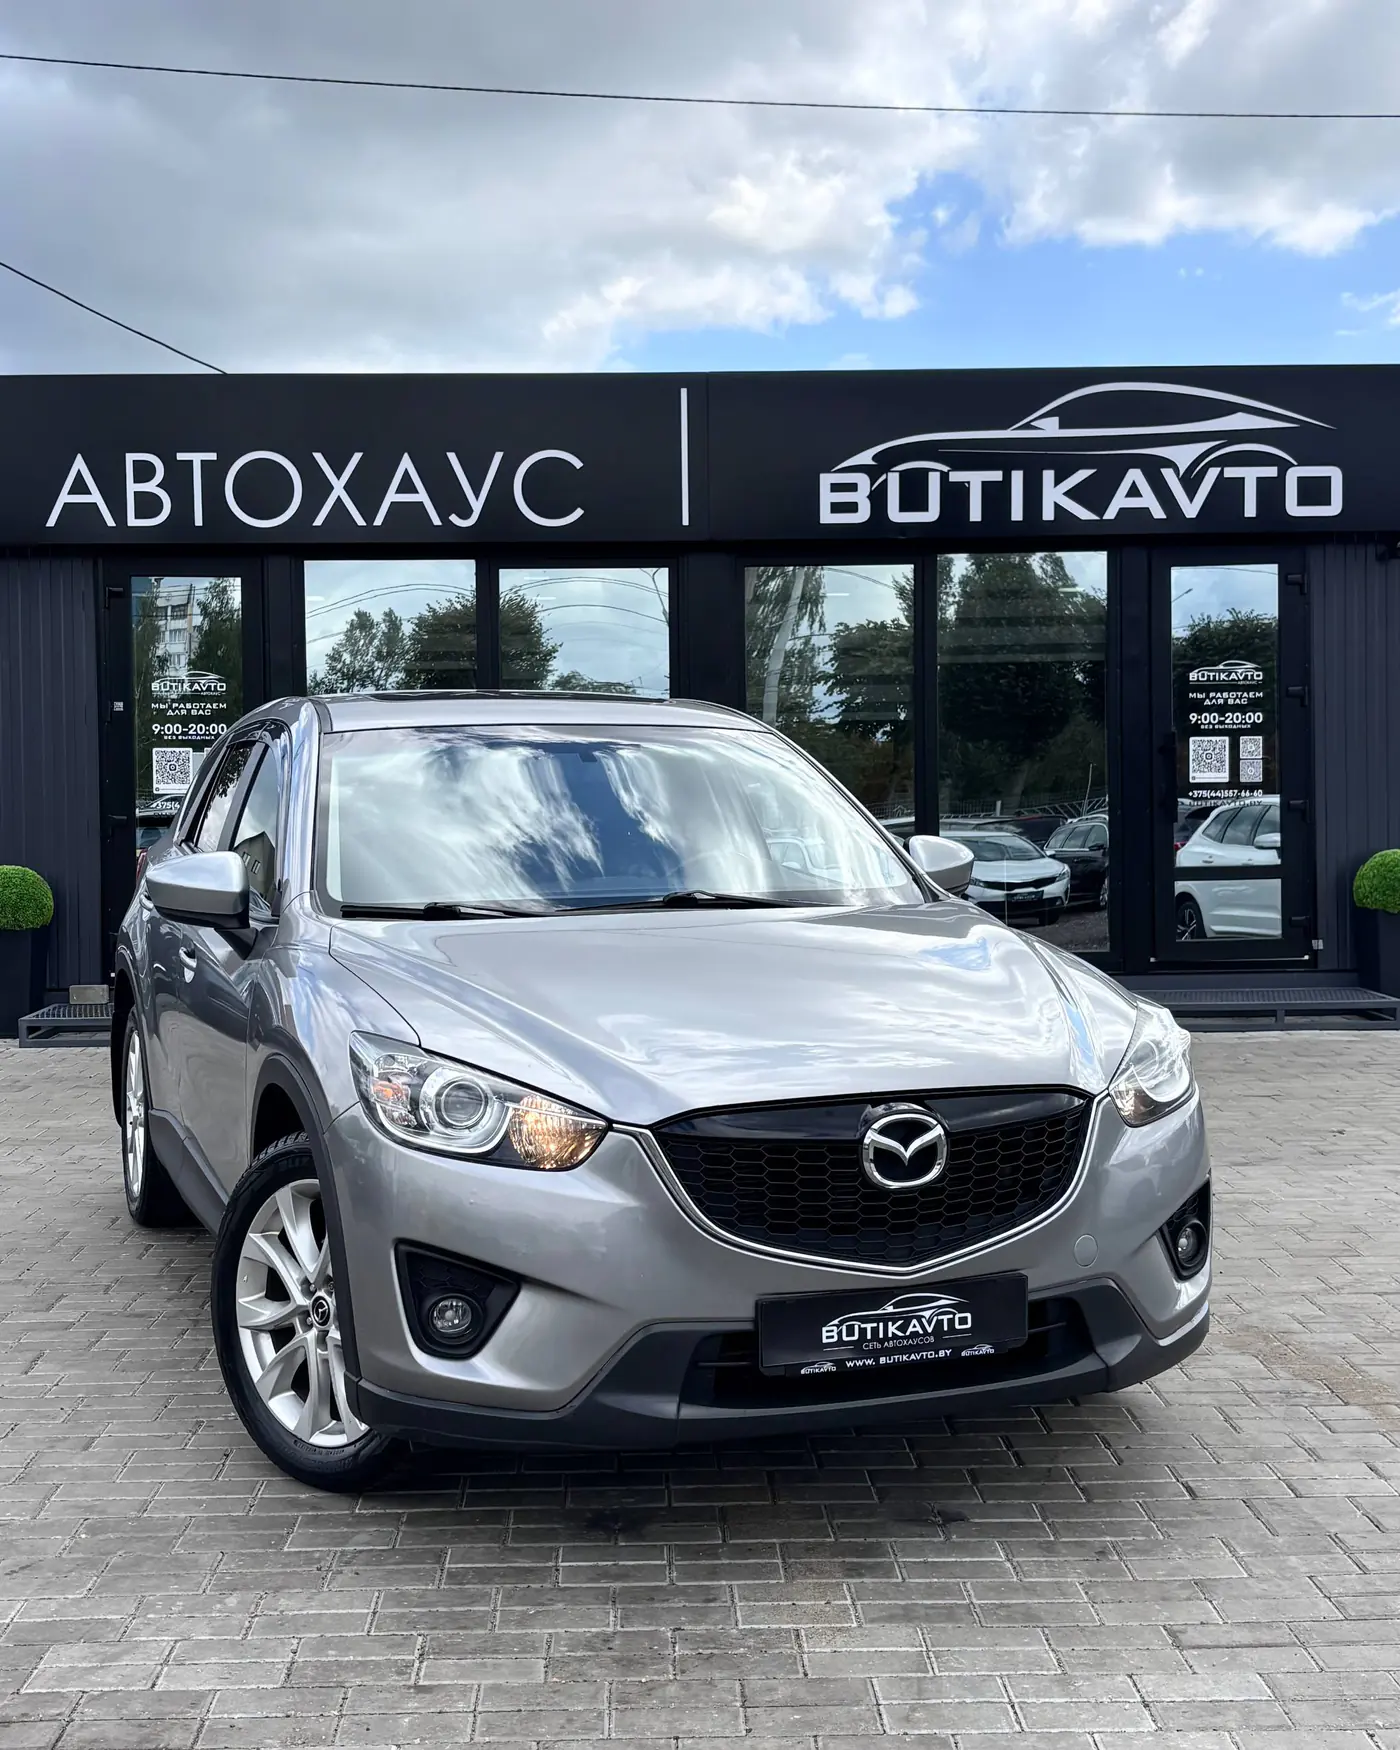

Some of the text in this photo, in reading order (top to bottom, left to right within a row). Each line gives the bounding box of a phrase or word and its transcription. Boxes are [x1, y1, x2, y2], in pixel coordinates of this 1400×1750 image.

[45, 449, 585, 528] АВТОХАУС
[819, 463, 1343, 525] BUTIKAVTO
[1189, 671, 1263, 681] BUTIKAVTO
[151, 682, 227, 692] BUTIKAVTO
[1209, 691, 1264, 699] РАБОТАЕМ
[1189, 712, 1263, 724] 9:00-20:00
[151, 723, 228, 735] 9:00-20:00
[821, 1312, 972, 1344] BUTIKAVTO
[862, 1335, 935, 1350] СЕТЬ АВТОХАУСОВ
[845, 1348, 953, 1368] WWW. BUTIKAVTO.BY
[960, 1347, 995, 1357] BUTIKAVTO
[800, 1365, 837, 1375] BUTIKAVTO
